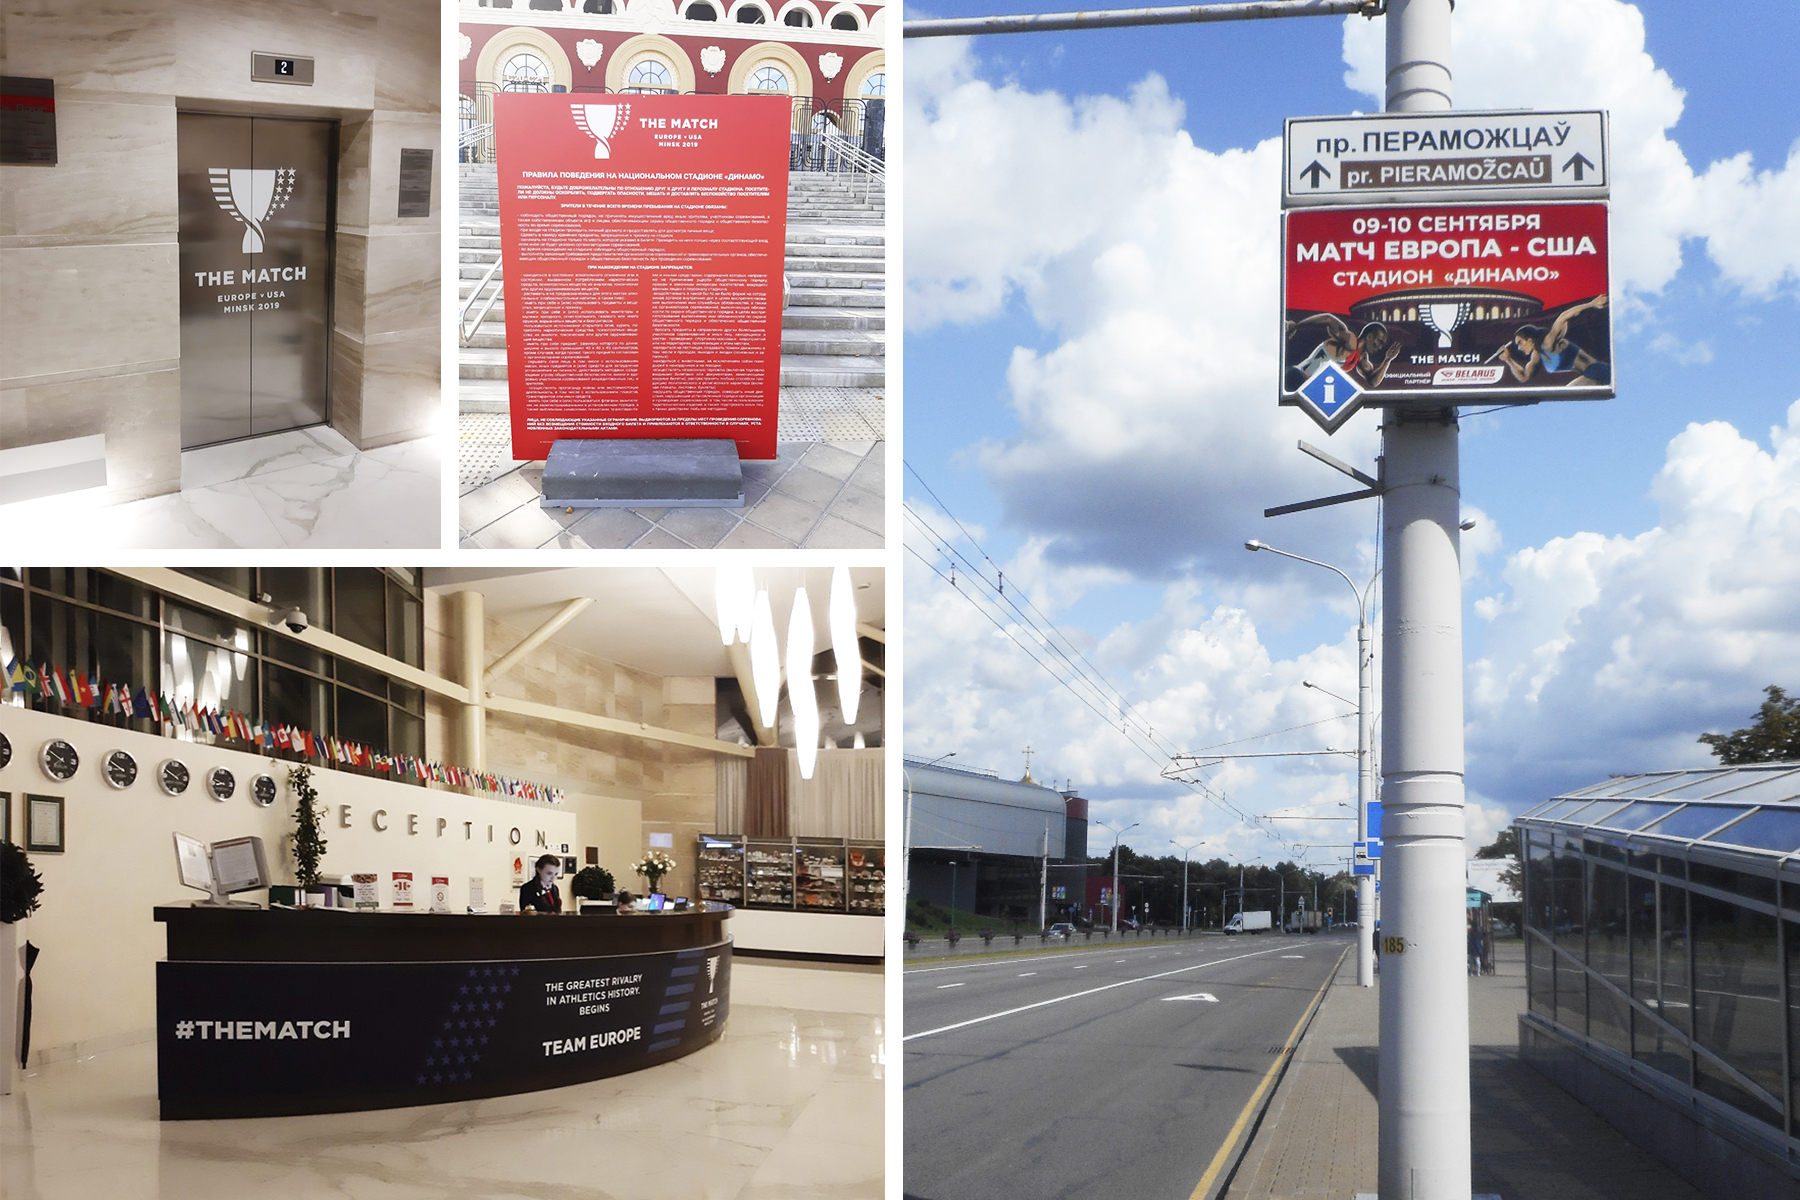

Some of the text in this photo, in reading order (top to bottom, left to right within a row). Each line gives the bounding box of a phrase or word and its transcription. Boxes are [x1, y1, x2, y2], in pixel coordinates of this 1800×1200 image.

[281, 61, 287, 74] 2
[640, 118, 718, 129] THE MATCH
[1316, 121, 1571, 158] пр. ПЕРАМОЖЦАЎ
[522, 170, 558, 178] ПРАВИЛА
[559, 171, 605, 179] ПОВЕДЕНИЯ
[618, 172, 682, 180] НАЦИОНАЛЬНОМ
[683, 172, 723, 180] СТАДИОНЕ
[1347, 169, 1372, 187] pr.
[1353, 214, 1541, 234] 09-10 СЕНТЯБРЯ
[1296, 242, 1375, 262] МАТЧ
[1384, 239, 1502, 260] ЕВРОПА
[1527, 236, 1596, 257] США
[195, 266, 307, 287] THE MATCH
[1333, 267, 1559, 288] СТАДИОН «ДИНАМО»
[218, 292, 257, 303] EUROPE
[267, 290, 285, 298] USA
[224, 302, 280, 313] MINSK 2019
[1410, 354, 1480, 364] THE MATCH
[1455, 370, 1496, 378] BELARUS
[339, 804, 546, 848] ECEPTION
[1384, 936, 1404, 953] 185
[545, 974, 643, 992] THE GREATEST RIVALRY
[546, 986, 640, 1005] IN ATHLETICS HISTORY.
[579, 1004, 610, 1015] BEGINS
[175, 1020, 351, 1040] #THEMATCH
[543, 1026, 641, 1056] TEAM EUROPE
